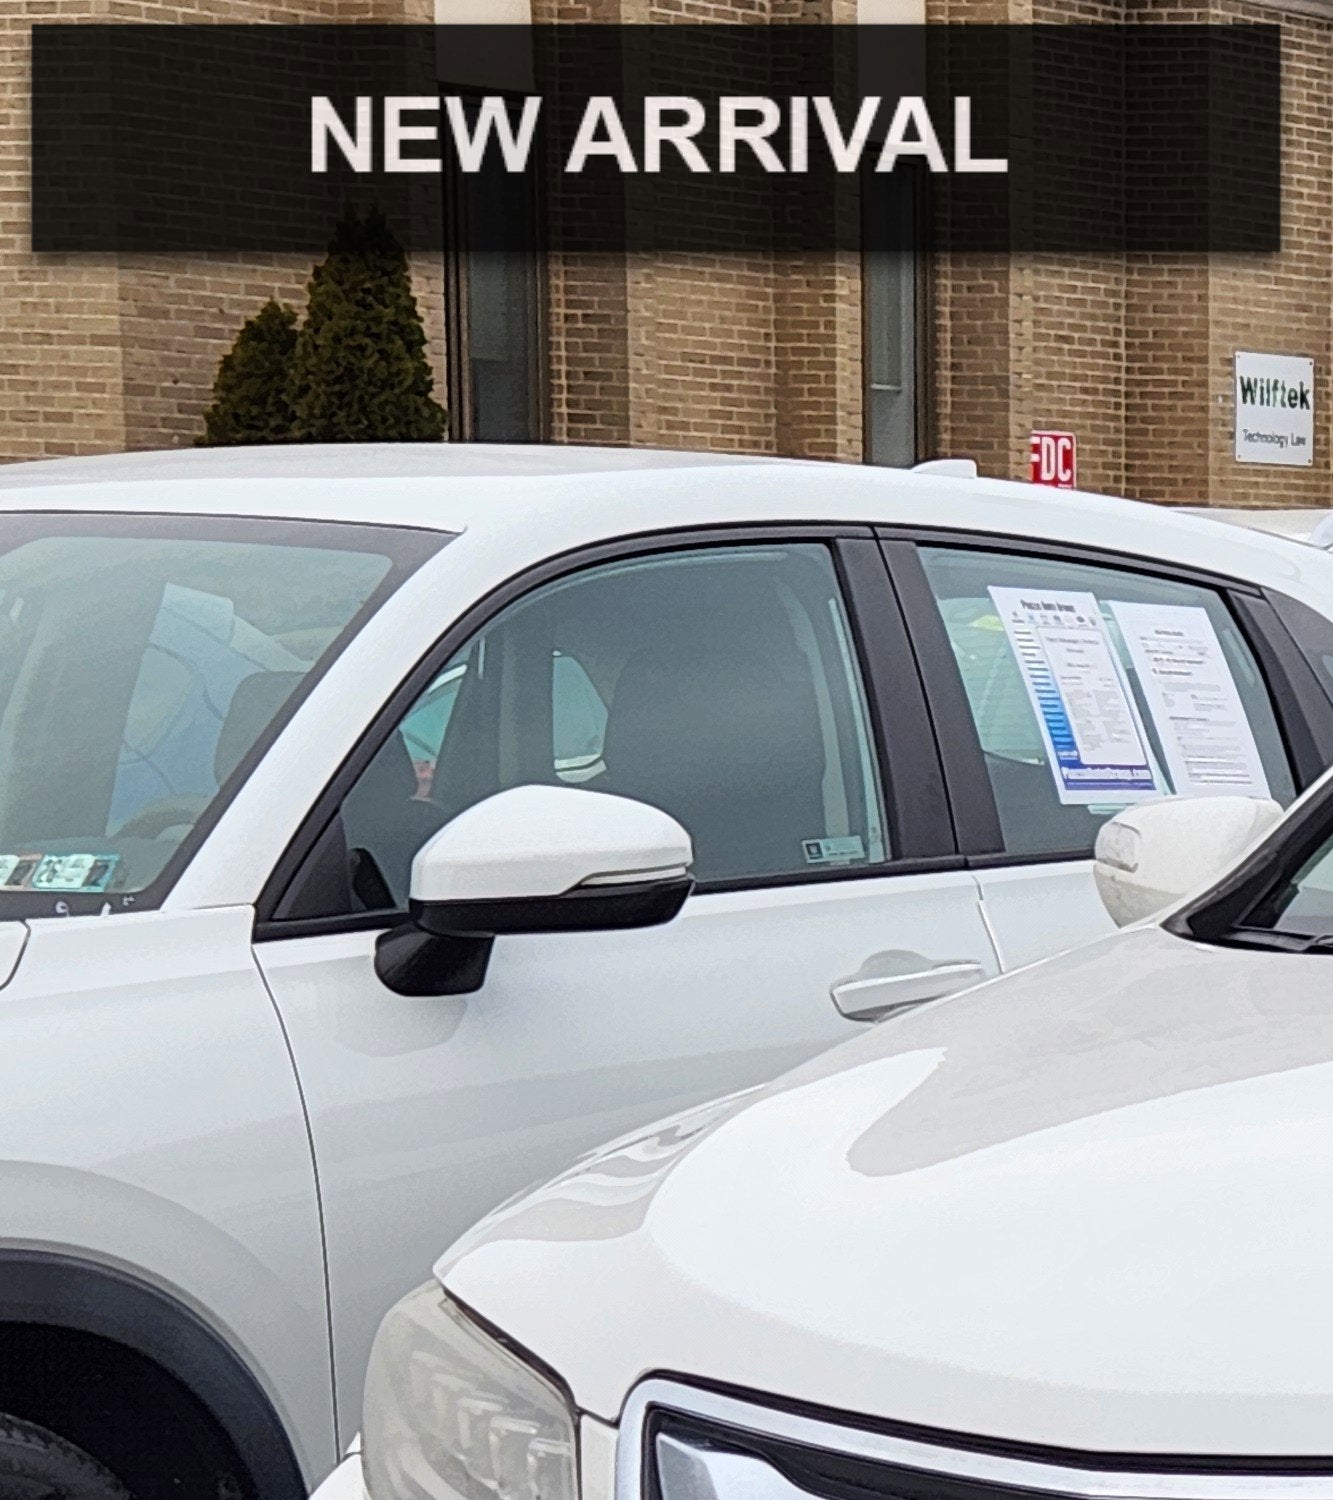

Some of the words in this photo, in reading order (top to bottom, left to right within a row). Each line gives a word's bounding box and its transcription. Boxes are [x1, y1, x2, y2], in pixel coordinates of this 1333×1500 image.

[1239, 375, 1311, 410] Wilftek
[1242, 428, 1289, 448] Technology
[1290, 432, 1307, 447] Law
